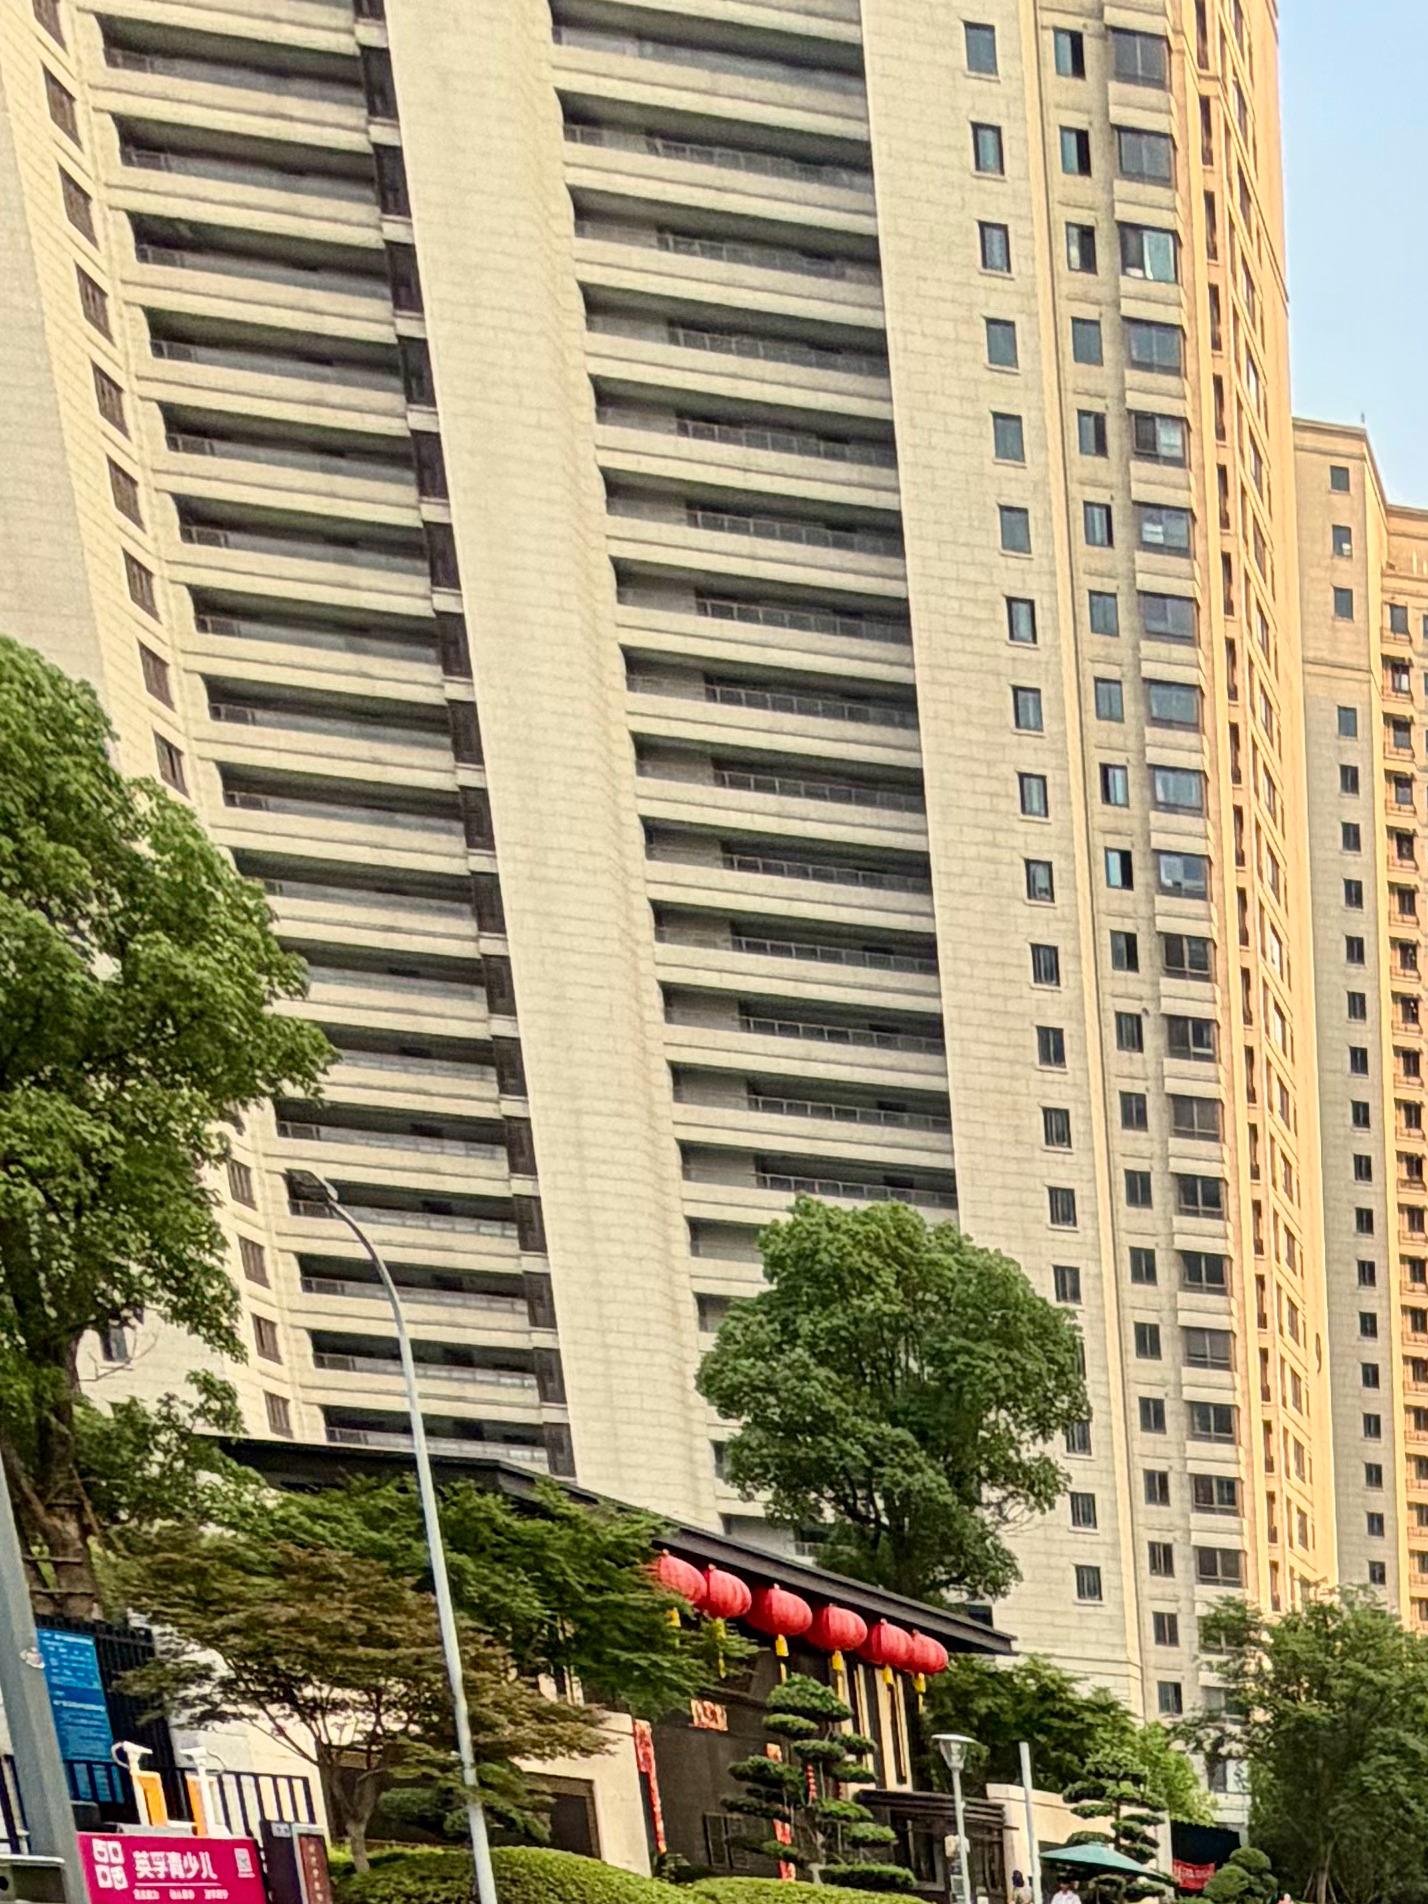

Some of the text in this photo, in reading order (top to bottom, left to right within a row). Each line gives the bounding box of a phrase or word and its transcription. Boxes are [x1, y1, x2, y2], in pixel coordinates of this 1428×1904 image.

[132, 1850, 218, 1880] 英孚青少儿
